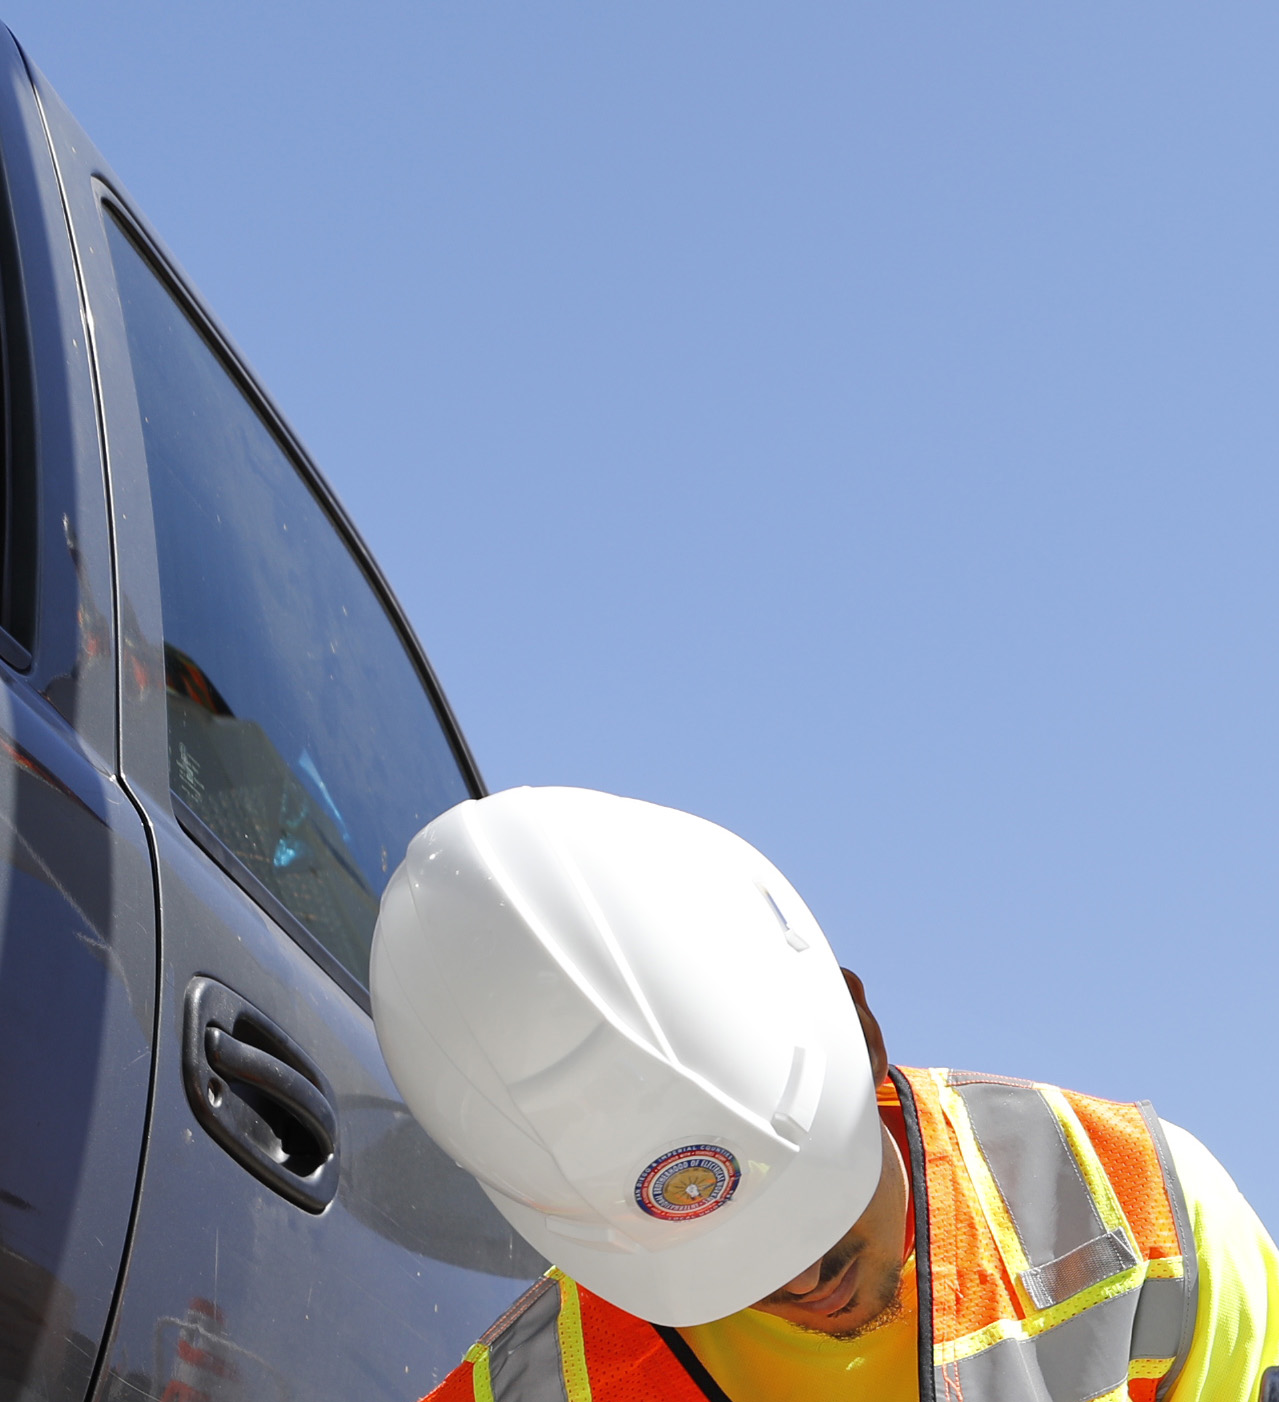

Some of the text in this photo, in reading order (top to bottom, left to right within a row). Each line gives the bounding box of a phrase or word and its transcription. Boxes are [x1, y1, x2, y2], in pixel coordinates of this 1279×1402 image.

[636, 1167, 652, 1188] DIEGO
[658, 1146, 697, 1162] IMPERIAL
[700, 1144, 733, 1160] COUNTIES
[690, 1160, 700, 1168] OF
